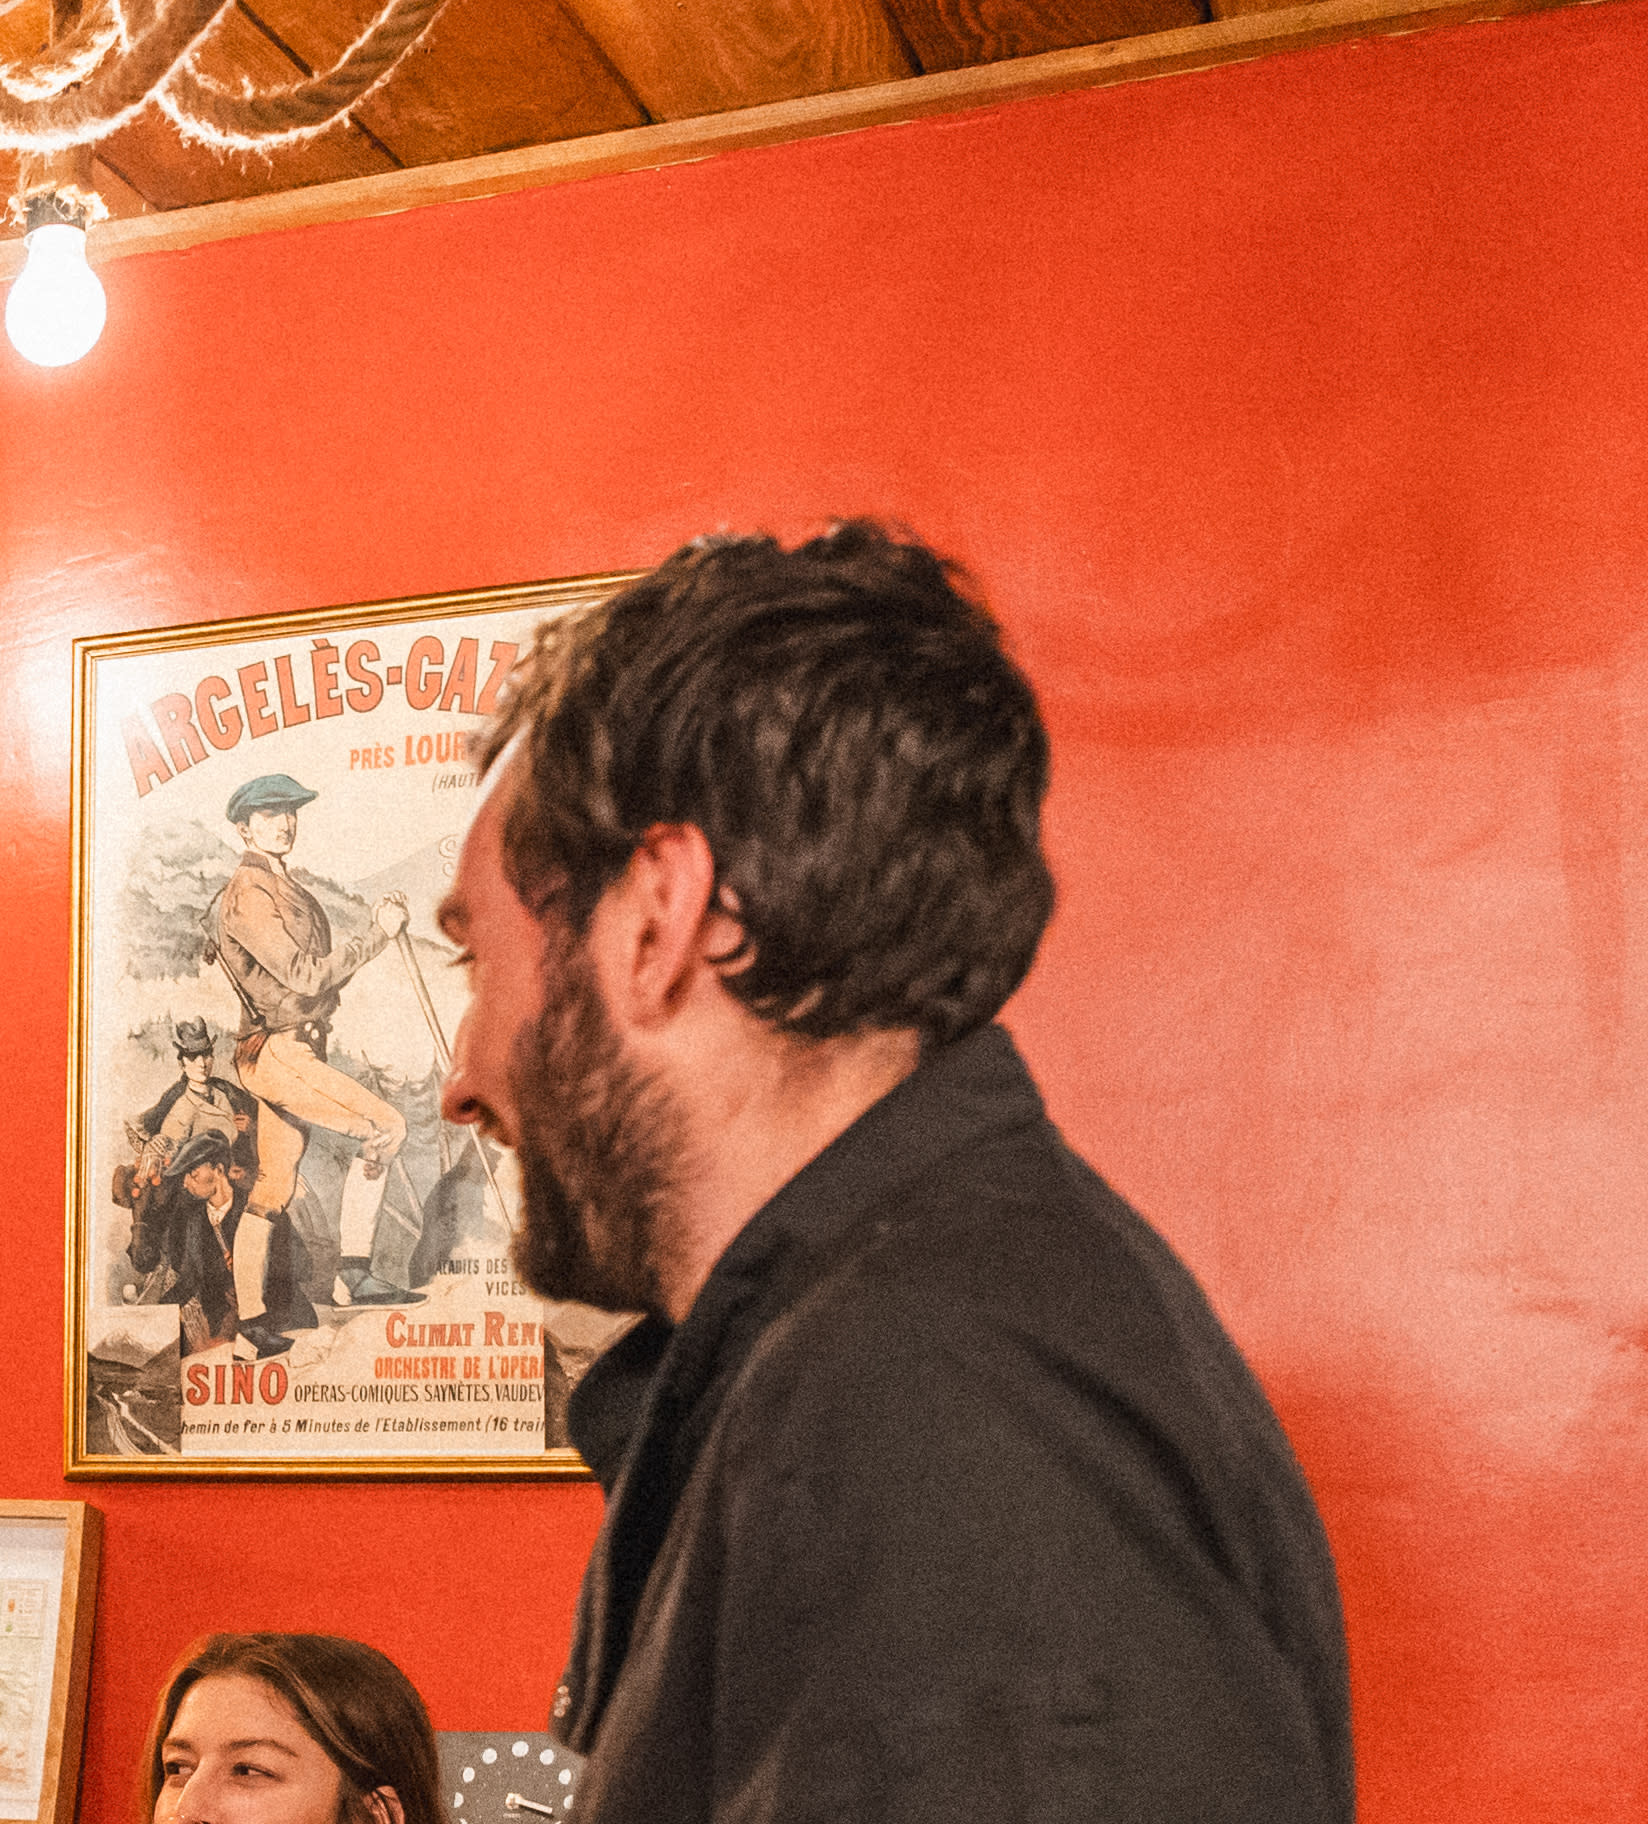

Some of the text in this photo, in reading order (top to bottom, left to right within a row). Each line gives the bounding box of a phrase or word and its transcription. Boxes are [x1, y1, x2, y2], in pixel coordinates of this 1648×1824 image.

[349, 743, 395, 771] PRÈS
[486, 1258, 507, 1275] DES
[385, 1311, 475, 1348] CLIMAT
[375, 1356, 456, 1380] ORCHESTRE
[463, 1356, 481, 1380] DE
[181, 1363, 289, 1406] SINO
[224, 1419, 239, 1434] de
[242, 1419, 265, 1434] fer
[269, 1417, 277, 1433] à
[282, 1418, 291, 1433] 5
[295, 1418, 350, 1434] Minutes
[354, 1418, 370, 1433] de
[485, 1415, 508, 1433] (16
